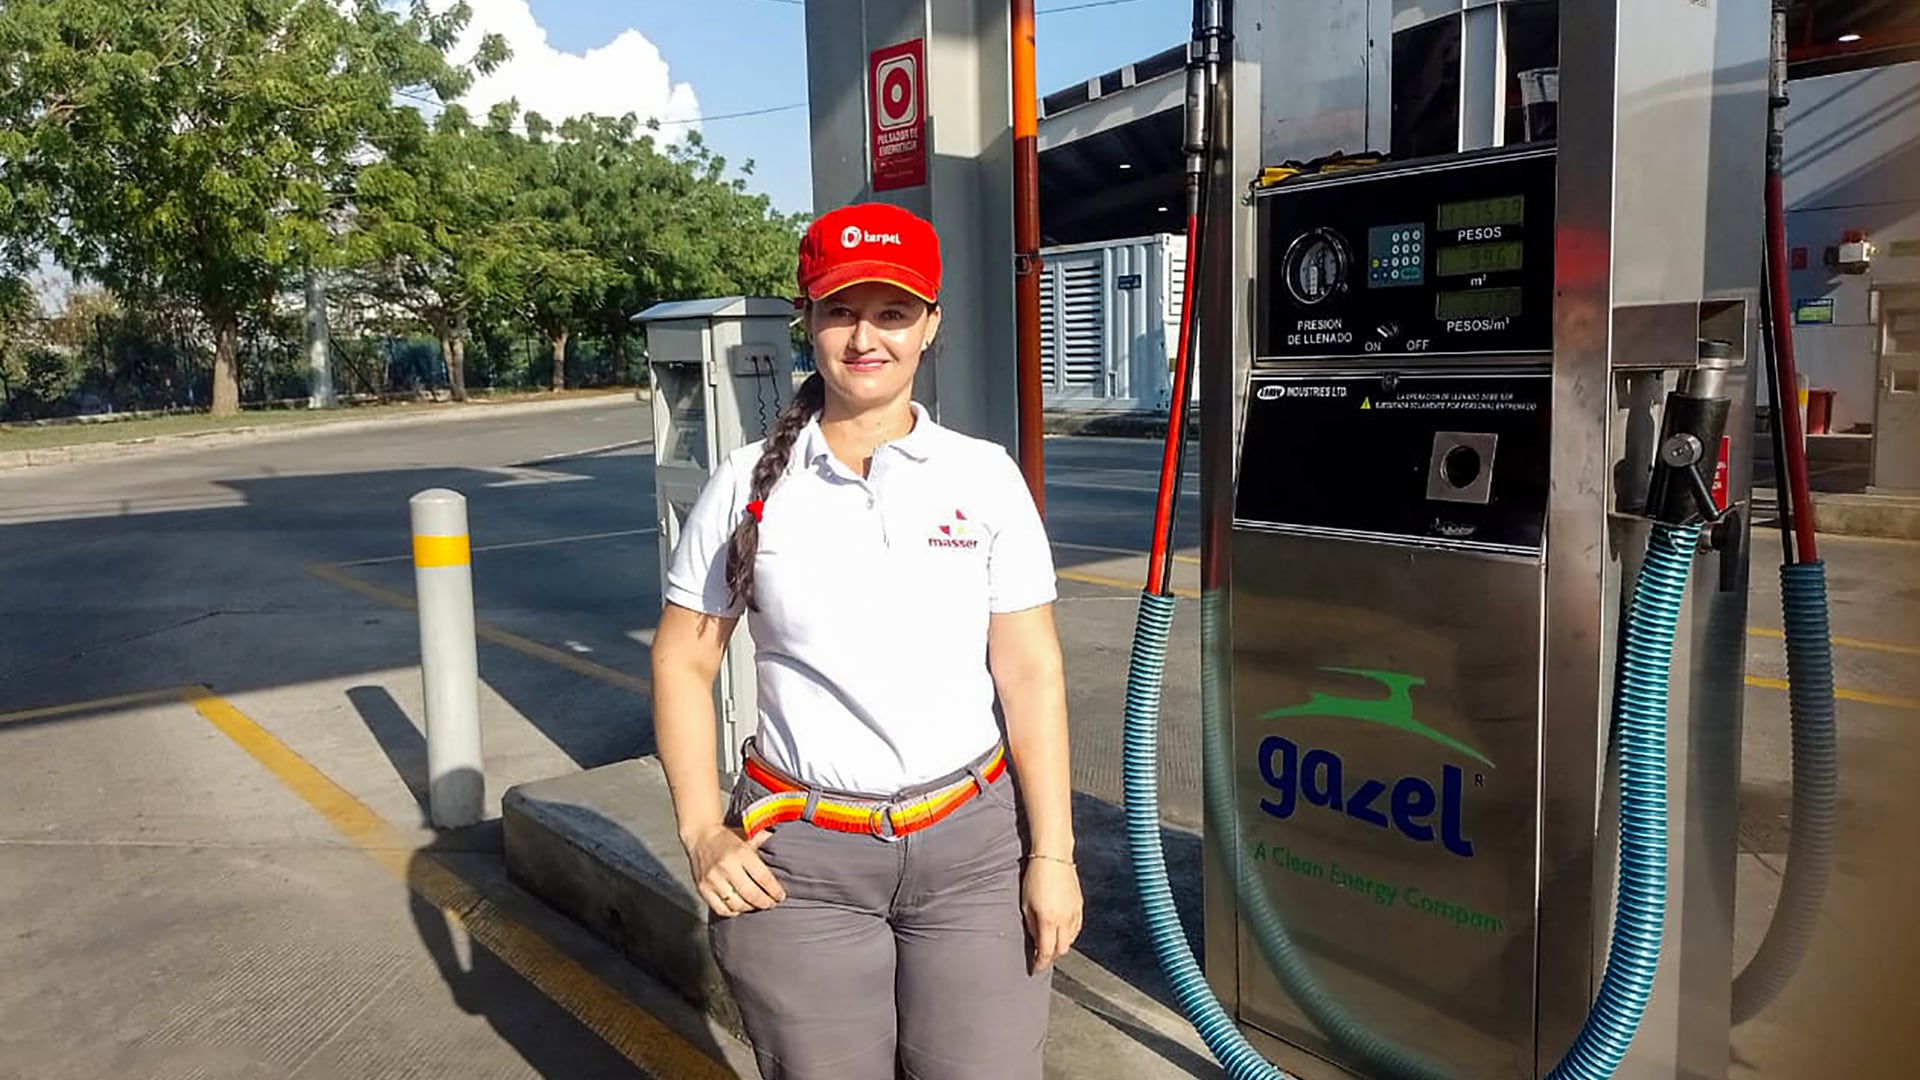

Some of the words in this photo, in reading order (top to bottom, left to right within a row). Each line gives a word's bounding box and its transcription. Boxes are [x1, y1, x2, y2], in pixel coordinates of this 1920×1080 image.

[864, 230, 901, 246] terpel
[1458, 226, 1502, 242] PESOS
[1297, 318, 1343, 331] PRESION
[1287, 334, 1301, 345] DE
[1303, 332, 1353, 345] LLENADO
[1406, 339, 1430, 351] OFF
[1364, 341, 1382, 352] ON
[928, 538, 979, 549] masser
[1257, 735, 1475, 858] gazel
[1253, 843, 1267, 861] A
[1273, 846, 1324, 878] Clean
[1330, 863, 1398, 906] Energy
